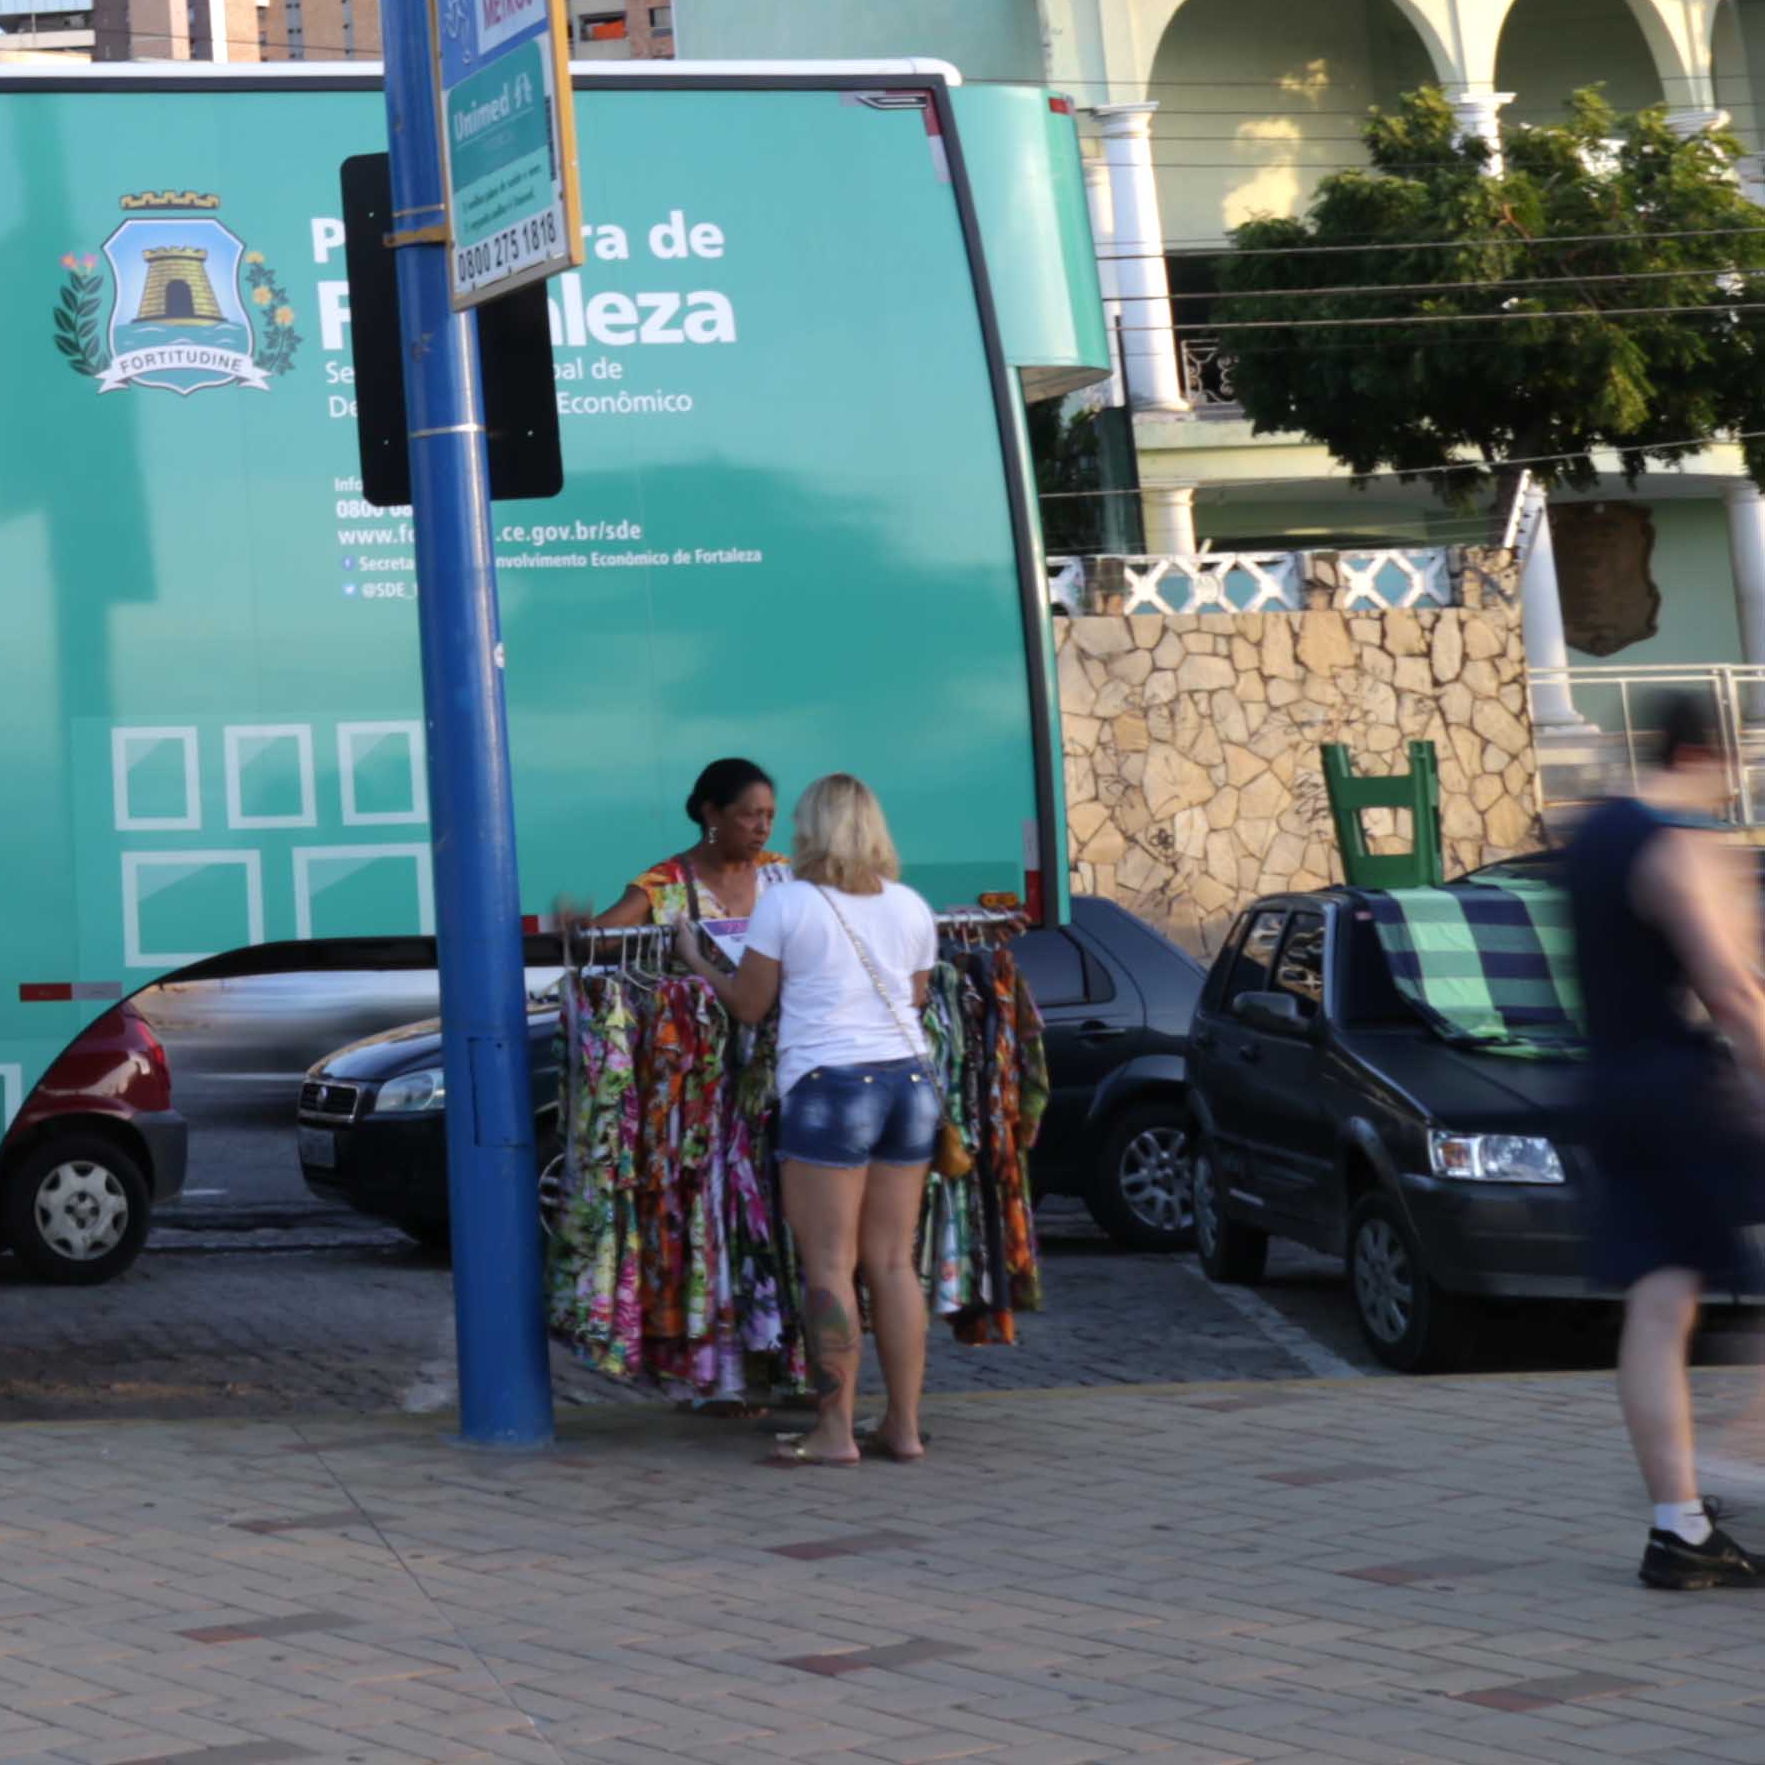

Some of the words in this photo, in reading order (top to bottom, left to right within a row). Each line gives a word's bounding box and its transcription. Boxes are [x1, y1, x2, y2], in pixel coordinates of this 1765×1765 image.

[453, 82, 510, 141] Unimed
[458, 241, 490, 283] 0800
[495, 230, 519, 268] 275
[523, 210, 556, 255] 1818
[648, 210, 725, 260] de
[120, 350, 243, 374] FORTITUDINE
[591, 356, 623, 380] de
[556, 388, 694, 416] Econômico
[591, 549, 669, 567] Econômico
[672, 548, 691, 565] de
[695, 547, 762, 564] Fortaleza
